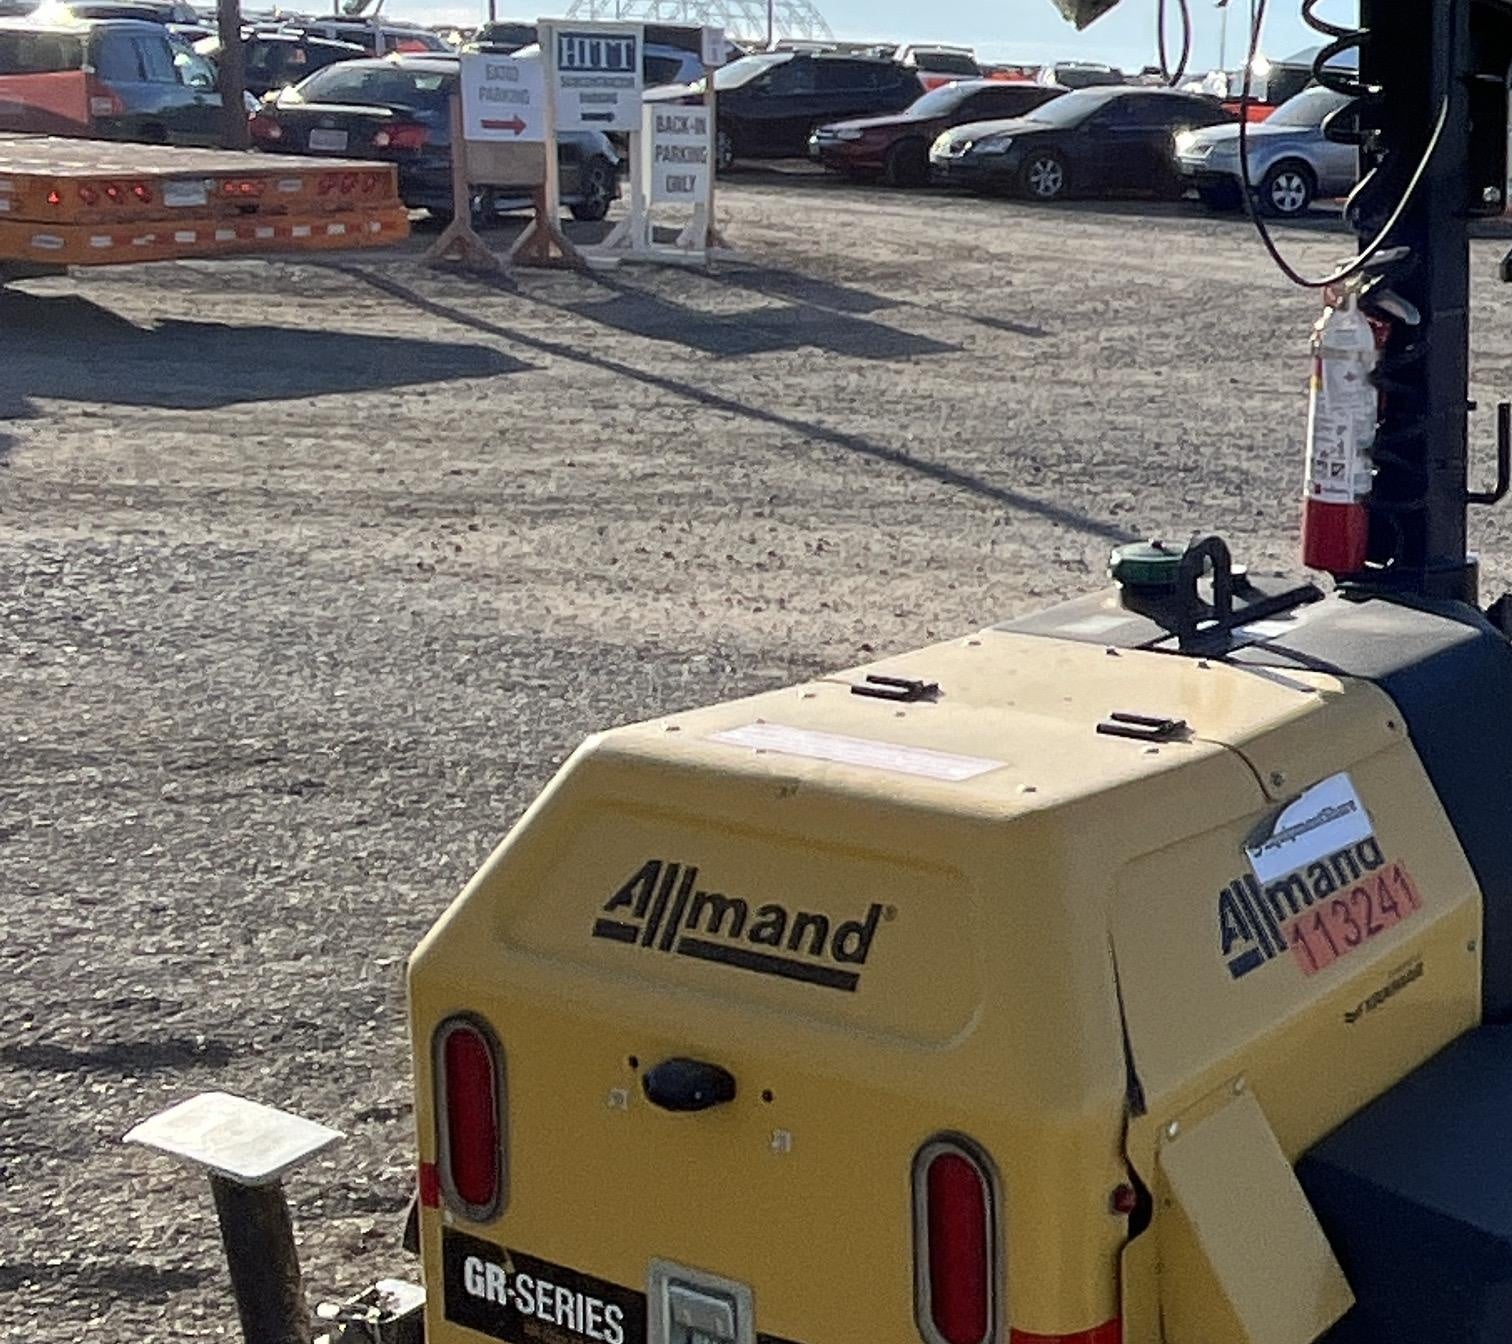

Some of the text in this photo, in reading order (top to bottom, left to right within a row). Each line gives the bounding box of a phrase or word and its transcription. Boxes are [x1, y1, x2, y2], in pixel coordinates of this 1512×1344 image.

[560, 37, 633, 69] HITT
[603, 859, 883, 965] Allmand
[1291, 863, 1418, 972] 113241
